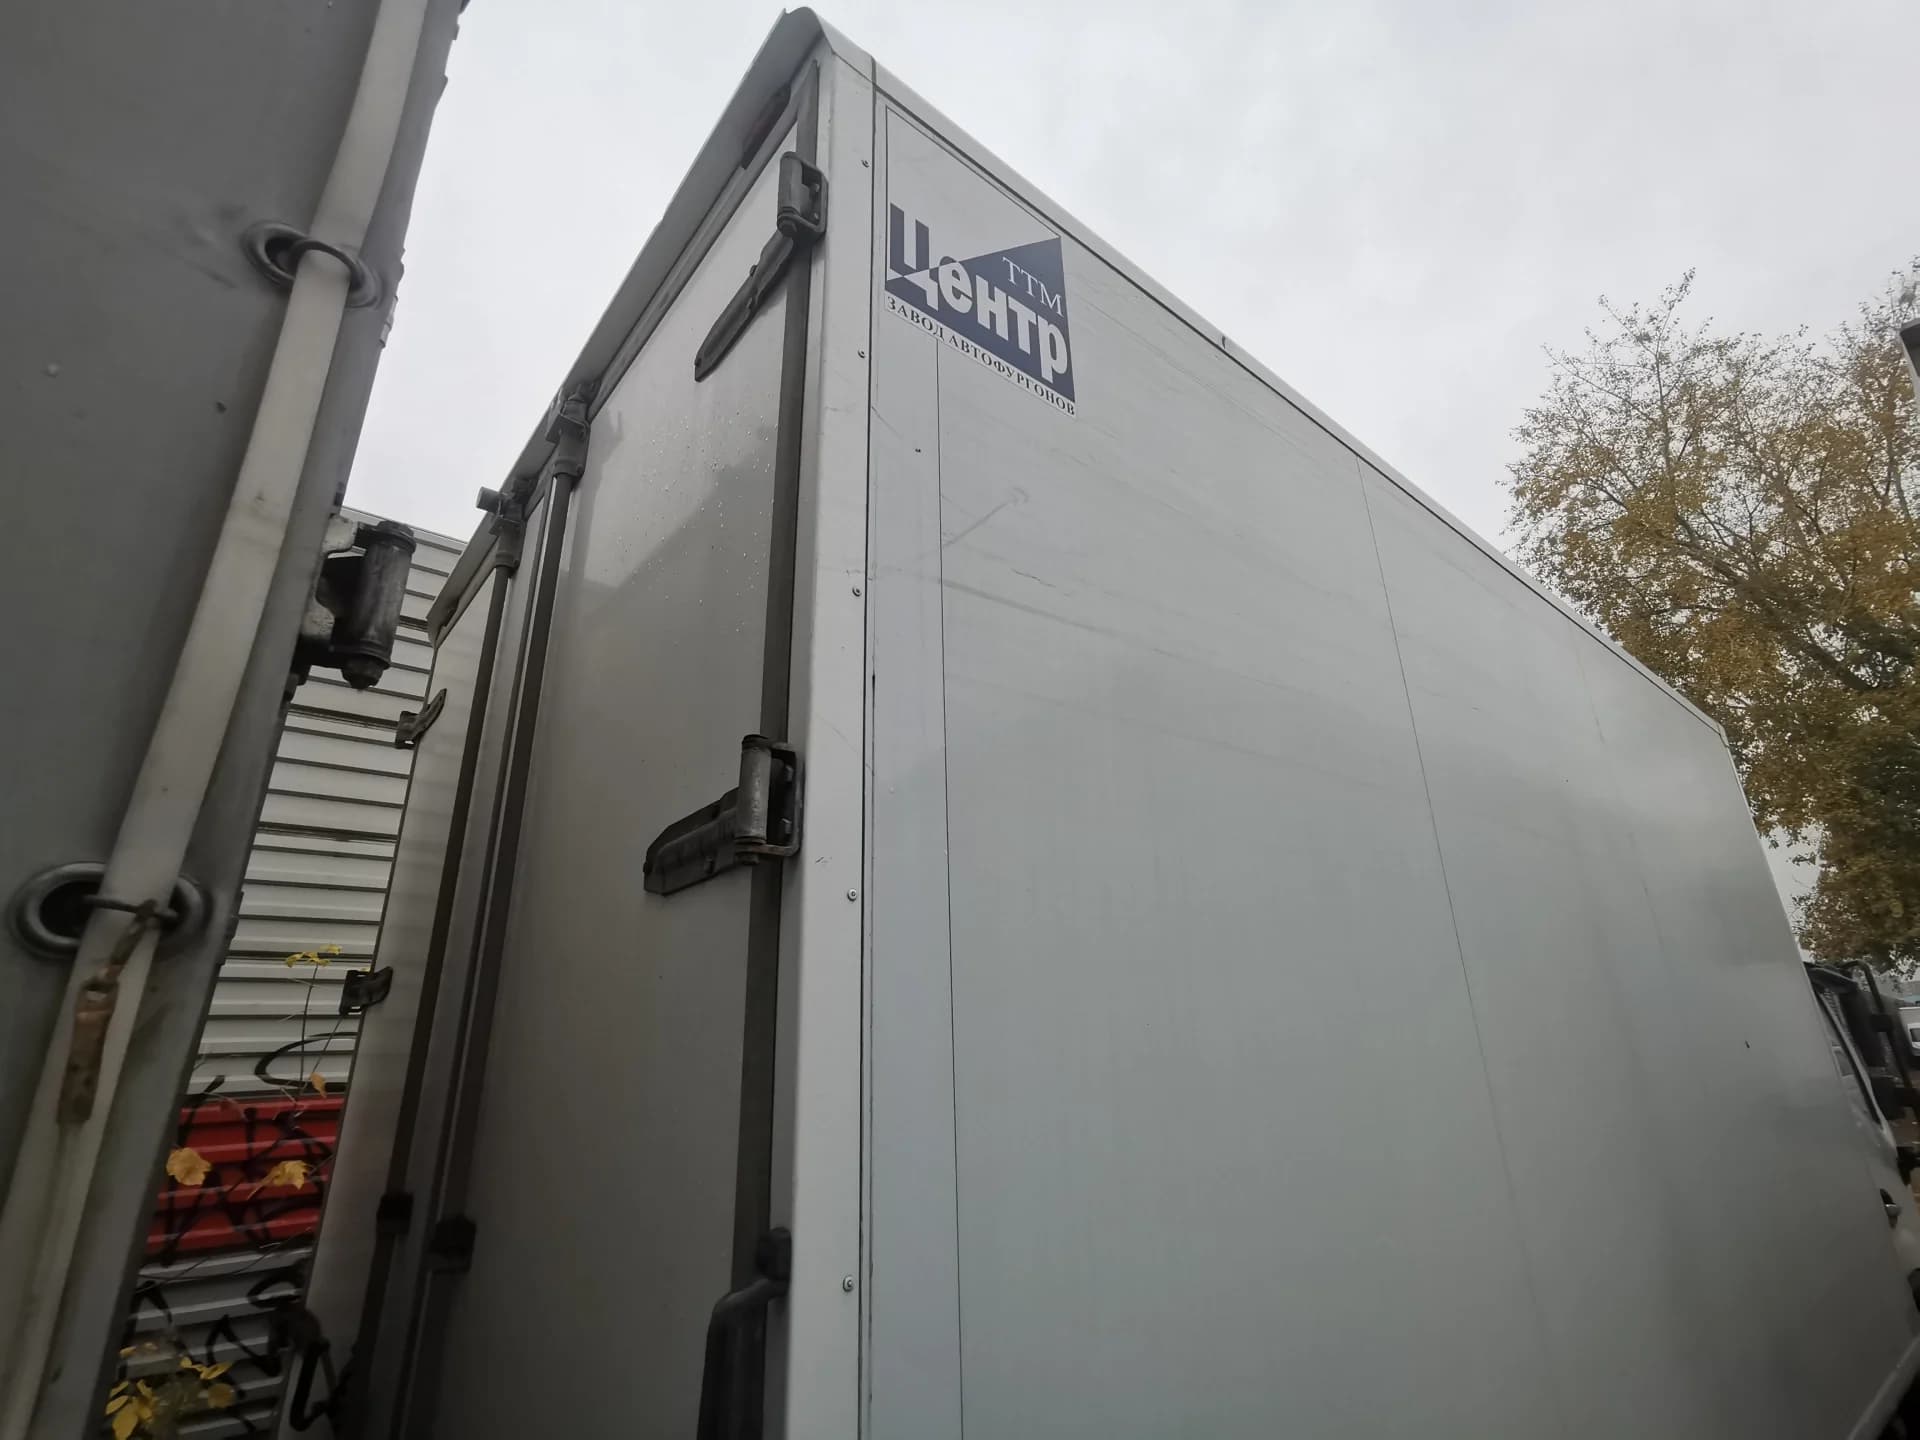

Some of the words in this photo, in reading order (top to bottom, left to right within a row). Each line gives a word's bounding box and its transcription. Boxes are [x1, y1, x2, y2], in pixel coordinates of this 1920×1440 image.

[889, 203, 1068, 383] Центр
[1002, 256, 1064, 318] ТТМ
[887, 296, 944, 341] ЗАВОД
[949, 335, 1075, 416] АВТОФУРГОНОВ
